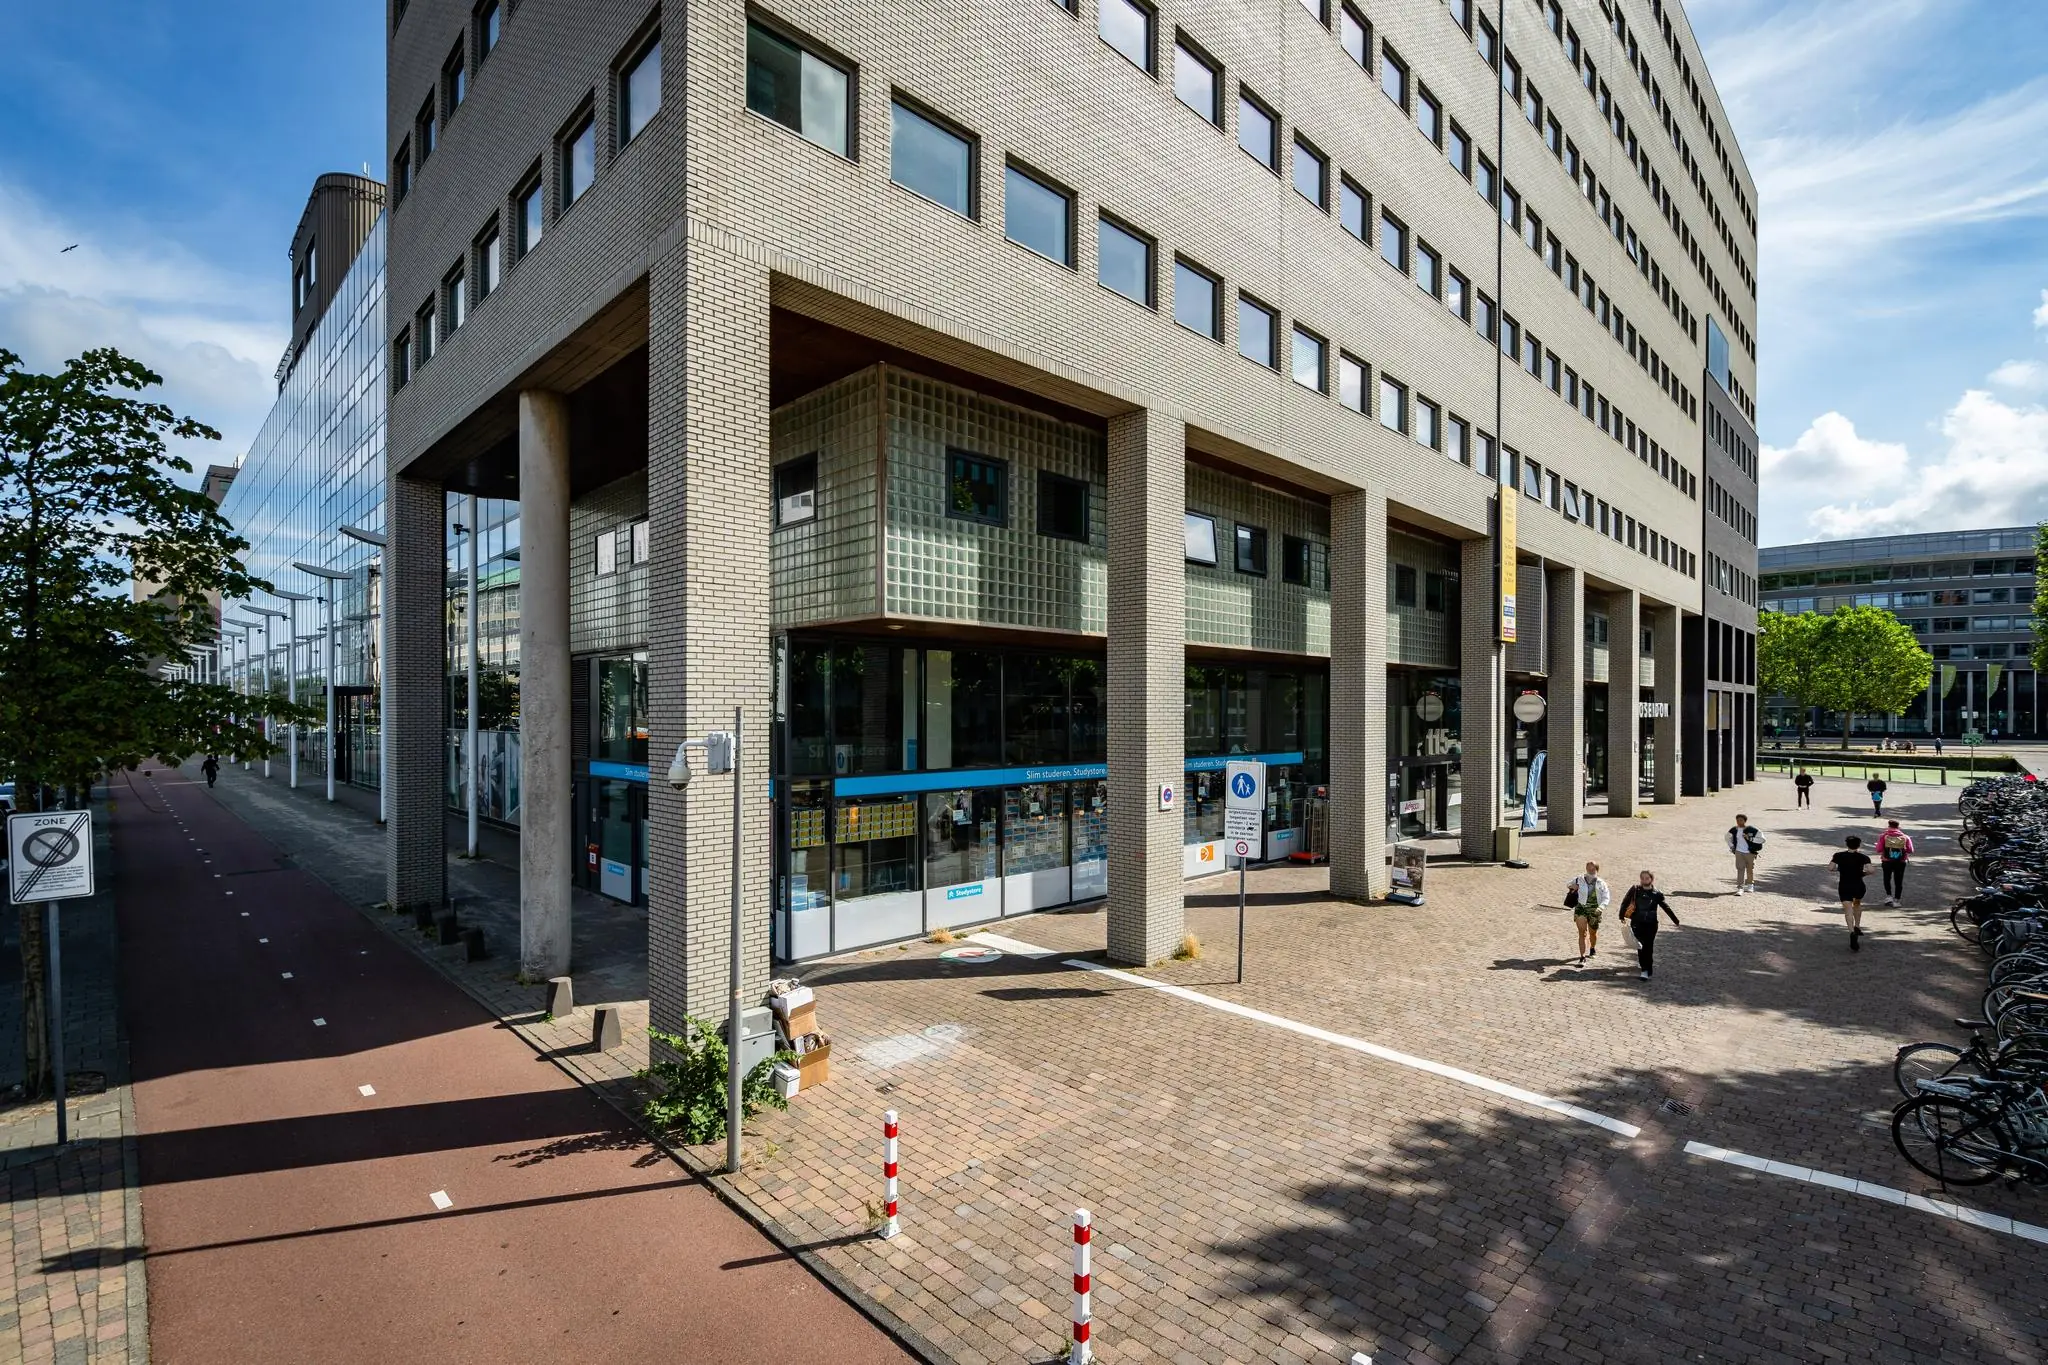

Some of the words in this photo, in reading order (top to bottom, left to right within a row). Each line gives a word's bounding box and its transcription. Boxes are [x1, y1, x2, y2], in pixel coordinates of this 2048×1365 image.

[1026, 769, 1041, 779] Slim
[1042, 769, 1072, 778] studeren.
[1073, 766, 1107, 777] Studystore.
[34, 817, 67, 827] ZONE
[955, 886, 982, 897] Studystore
